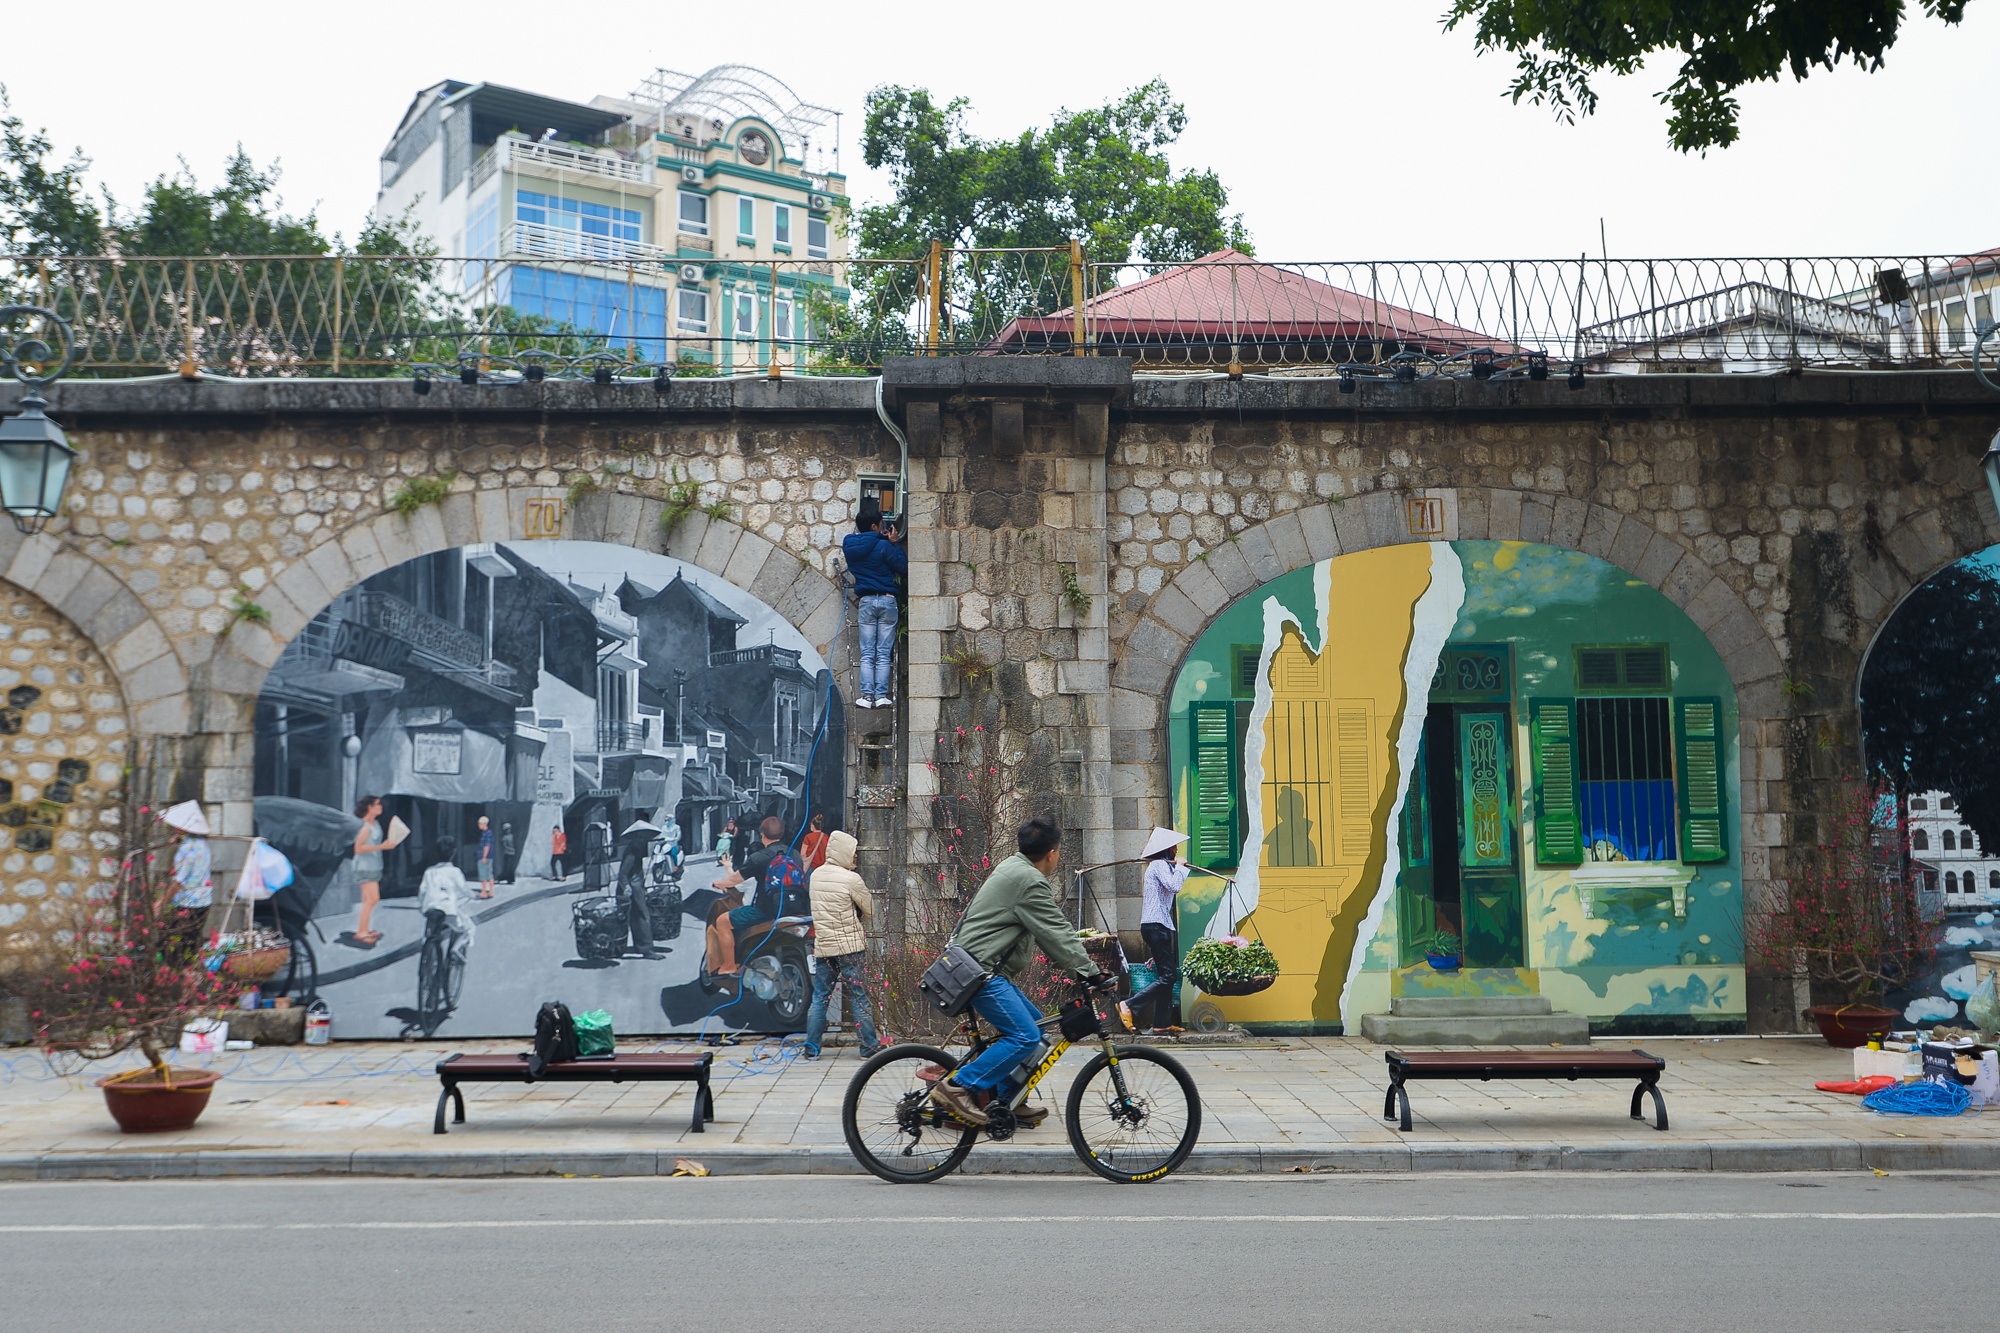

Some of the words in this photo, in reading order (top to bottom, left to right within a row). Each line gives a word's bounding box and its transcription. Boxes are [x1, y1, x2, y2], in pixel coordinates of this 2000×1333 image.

[529, 503, 555, 532] 70
[1415, 502, 1436, 529] 71
[1027, 1041, 1066, 1089] GIANT
[1131, 1166, 1168, 1181] MAXXIS
